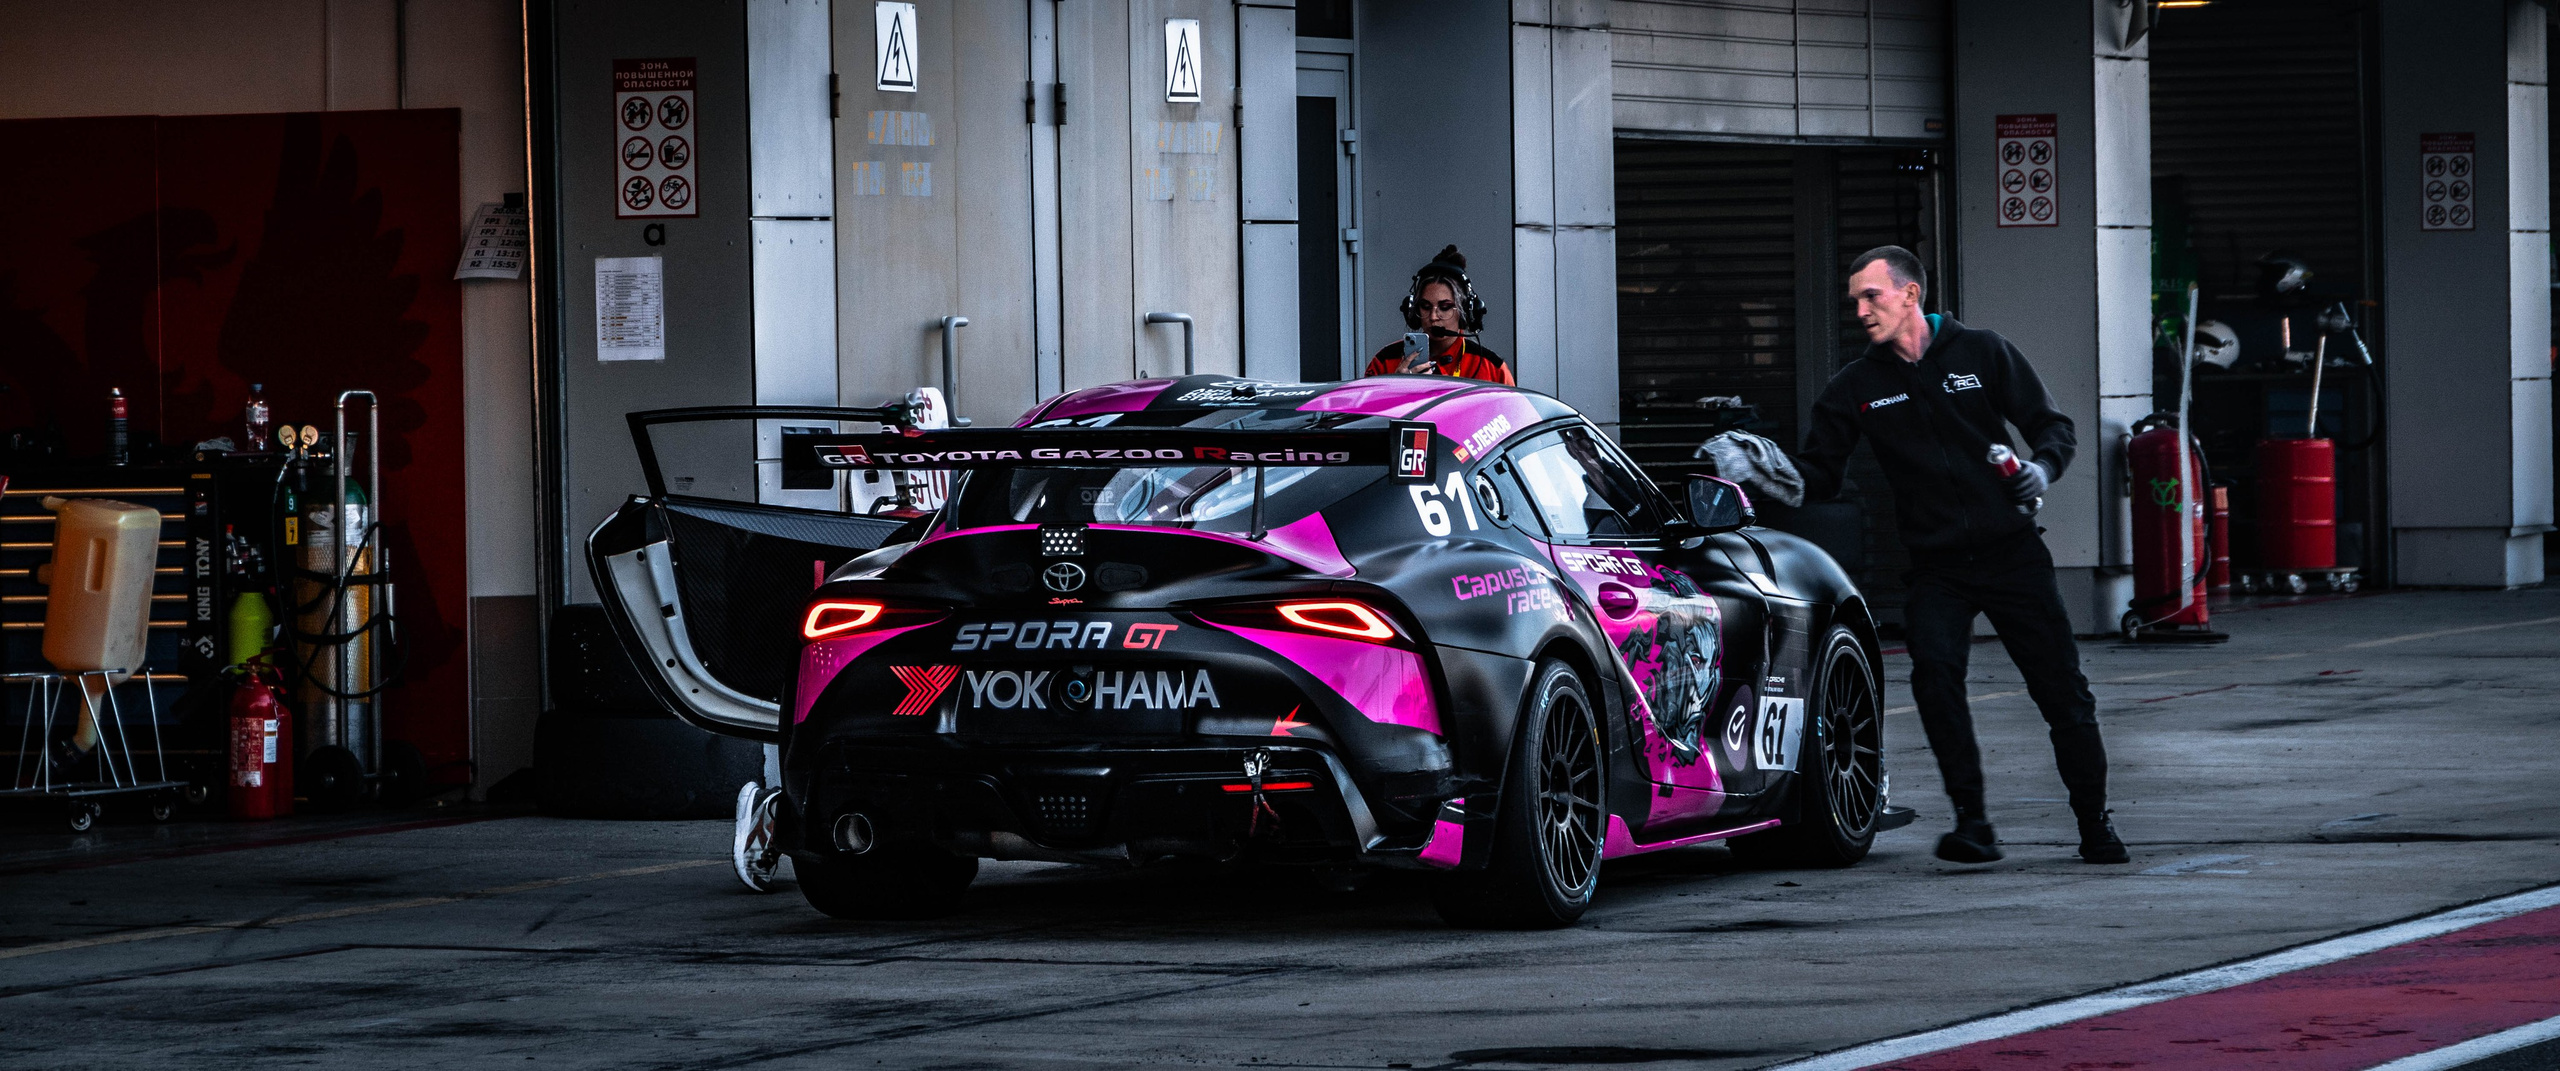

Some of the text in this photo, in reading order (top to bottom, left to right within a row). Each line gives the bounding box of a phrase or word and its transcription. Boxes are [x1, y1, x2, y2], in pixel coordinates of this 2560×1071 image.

[615, 69, 694, 80] ПОВЫШЕННОЙ
[640, 62, 669, 70] ЗОНА
[623, 79, 689, 89] ОПАСНОСТИ
[484, 217, 501, 225] FP1
[480, 239, 488, 247] Q
[474, 249, 522, 257] R1 13:15
[469, 260, 518, 268] R2 15:55
[1869, 392, 1910, 410] YOKOHAMA
[822, 446, 1350, 465] GR TOYOTA GAZOO Racing
[1400, 448, 1425, 472] GR
[1408, 470, 1479, 537] 61
[1559, 551, 1648, 577] SPORA GT
[196, 537, 211, 621] KING TONY
[951, 621, 1179, 651] SPORA GT
[1762, 702, 1788, 766] 61
